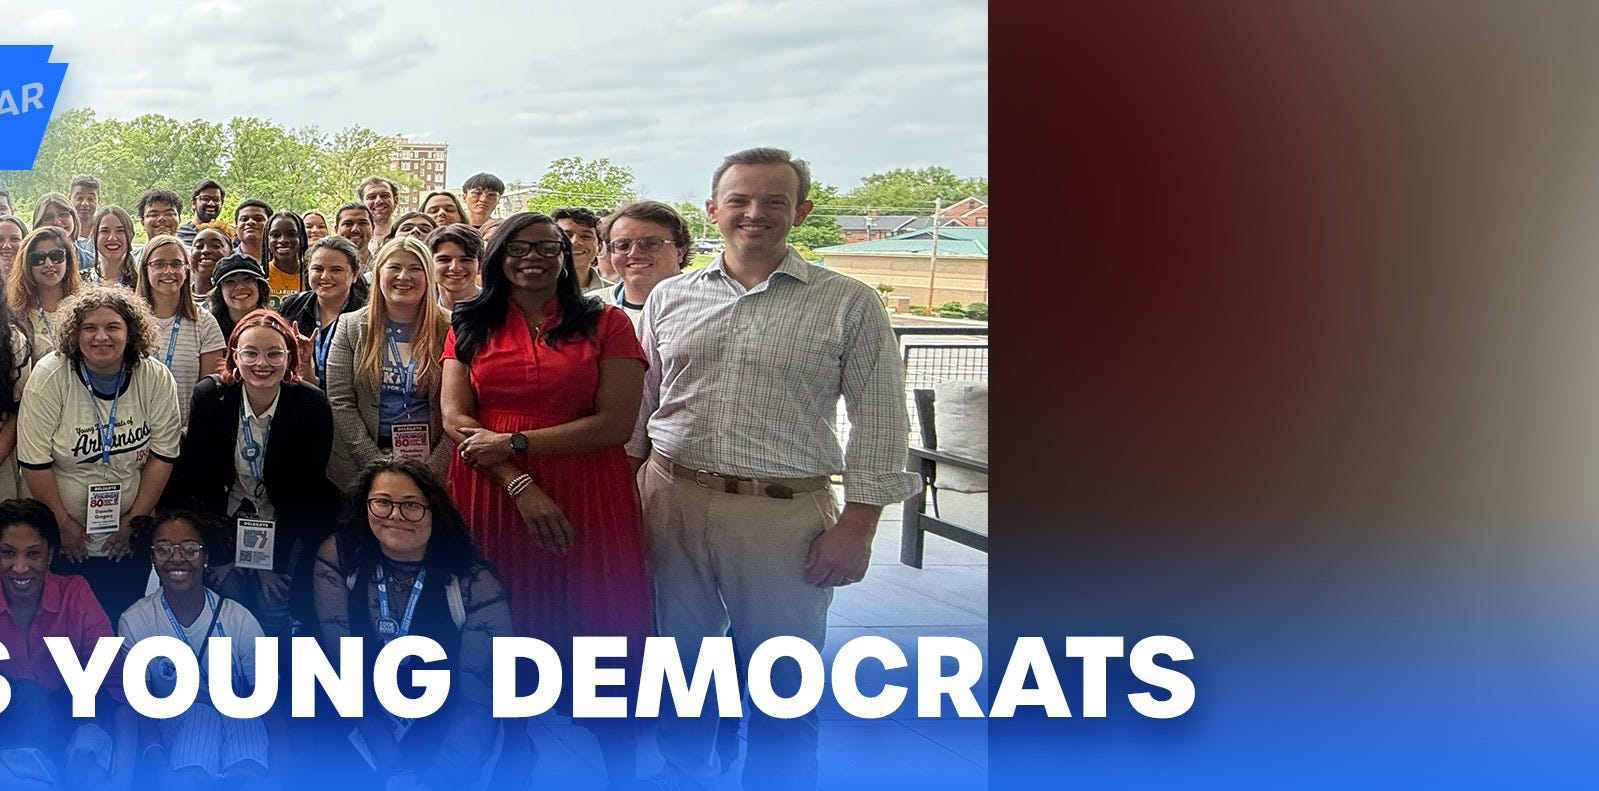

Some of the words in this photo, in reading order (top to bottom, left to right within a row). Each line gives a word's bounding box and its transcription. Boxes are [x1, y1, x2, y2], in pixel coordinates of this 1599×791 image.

[75, 426, 95, 435] Young
[126, 416, 134, 425] of
[395, 439, 410, 447] 80
[90, 499, 103, 507] 80
